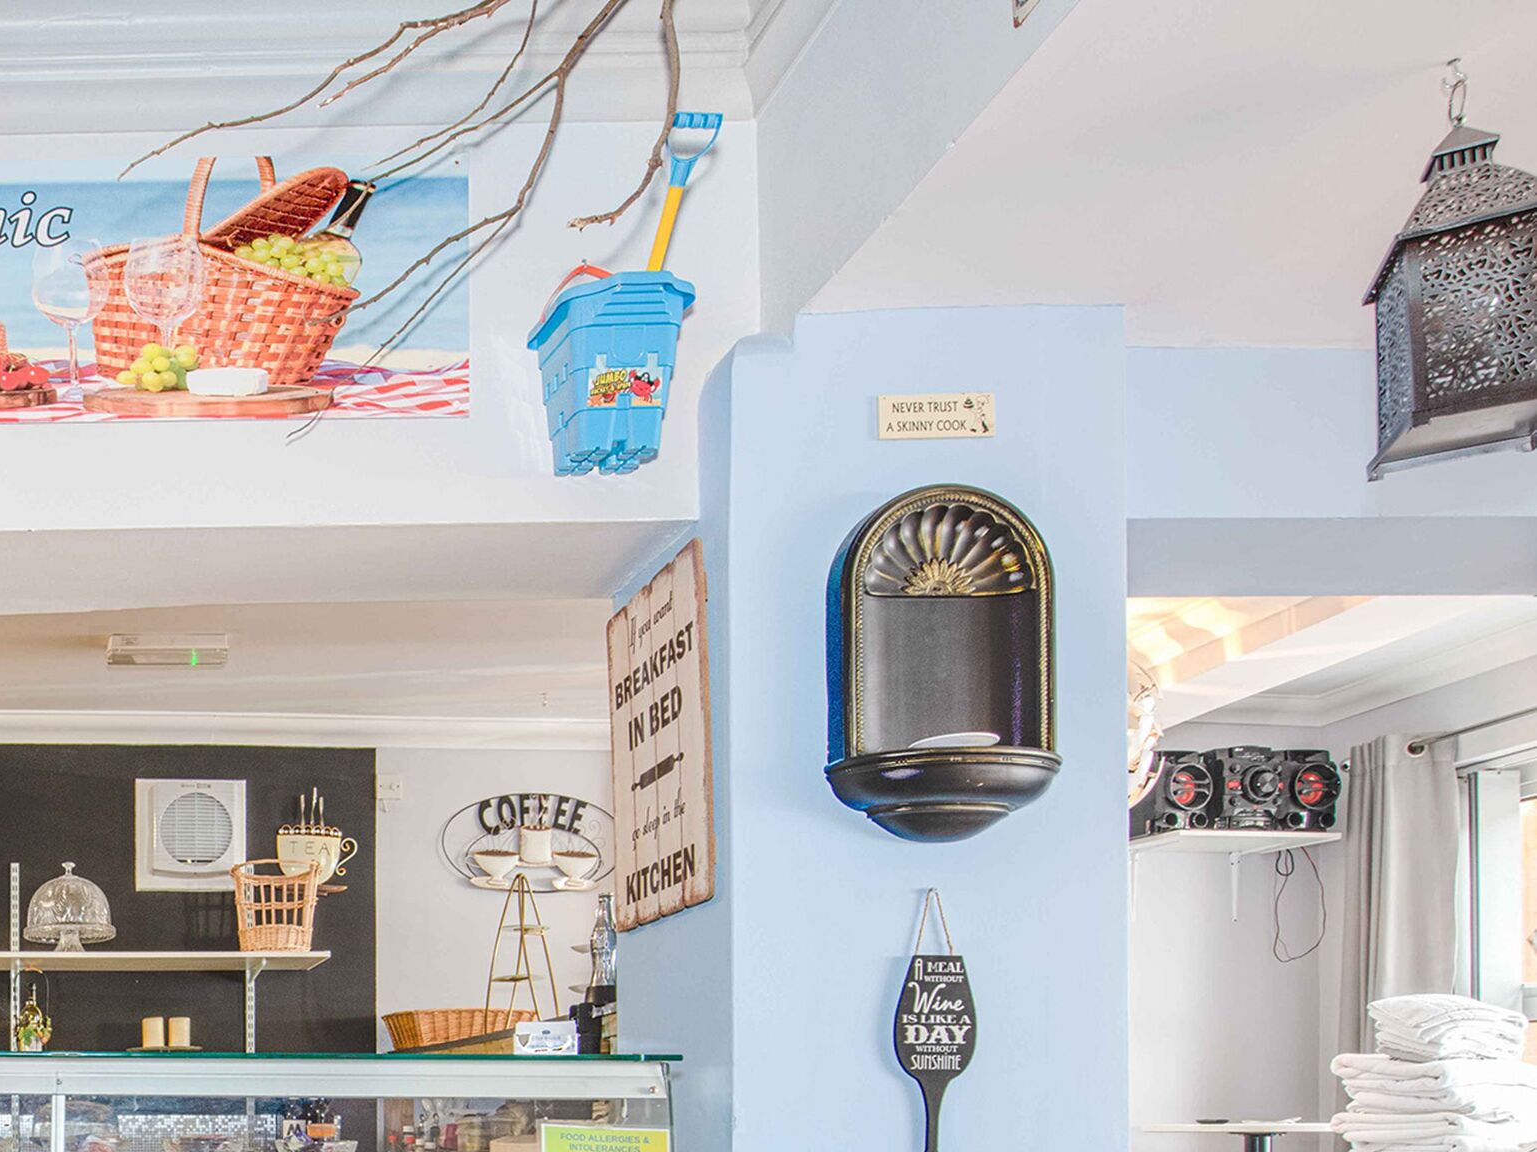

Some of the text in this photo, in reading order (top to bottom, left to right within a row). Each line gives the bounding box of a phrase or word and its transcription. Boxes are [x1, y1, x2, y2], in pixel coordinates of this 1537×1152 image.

[892, 400, 958, 413] NEVER TRUST
[886, 419, 967, 432] A SKINNY COOK
[615, 620, 694, 711] BREAKFAST
[628, 685, 682, 752] IN BED
[478, 793, 589, 836] COFFEE
[289, 840, 331, 856] TEA
[626, 843, 695, 906] KITCHEN
[914, 958, 965, 981] A MEAL
[924, 975, 965, 983] WITHOUT
[908, 981, 965, 1014] Wine
[902, 1014, 972, 1024] IS LIKE A
[903, 1024, 972, 1045] DAY
[915, 1045, 959, 1053] WITHOUT
[560, 1132, 650, 1144] FOOD ALLERGIES &
